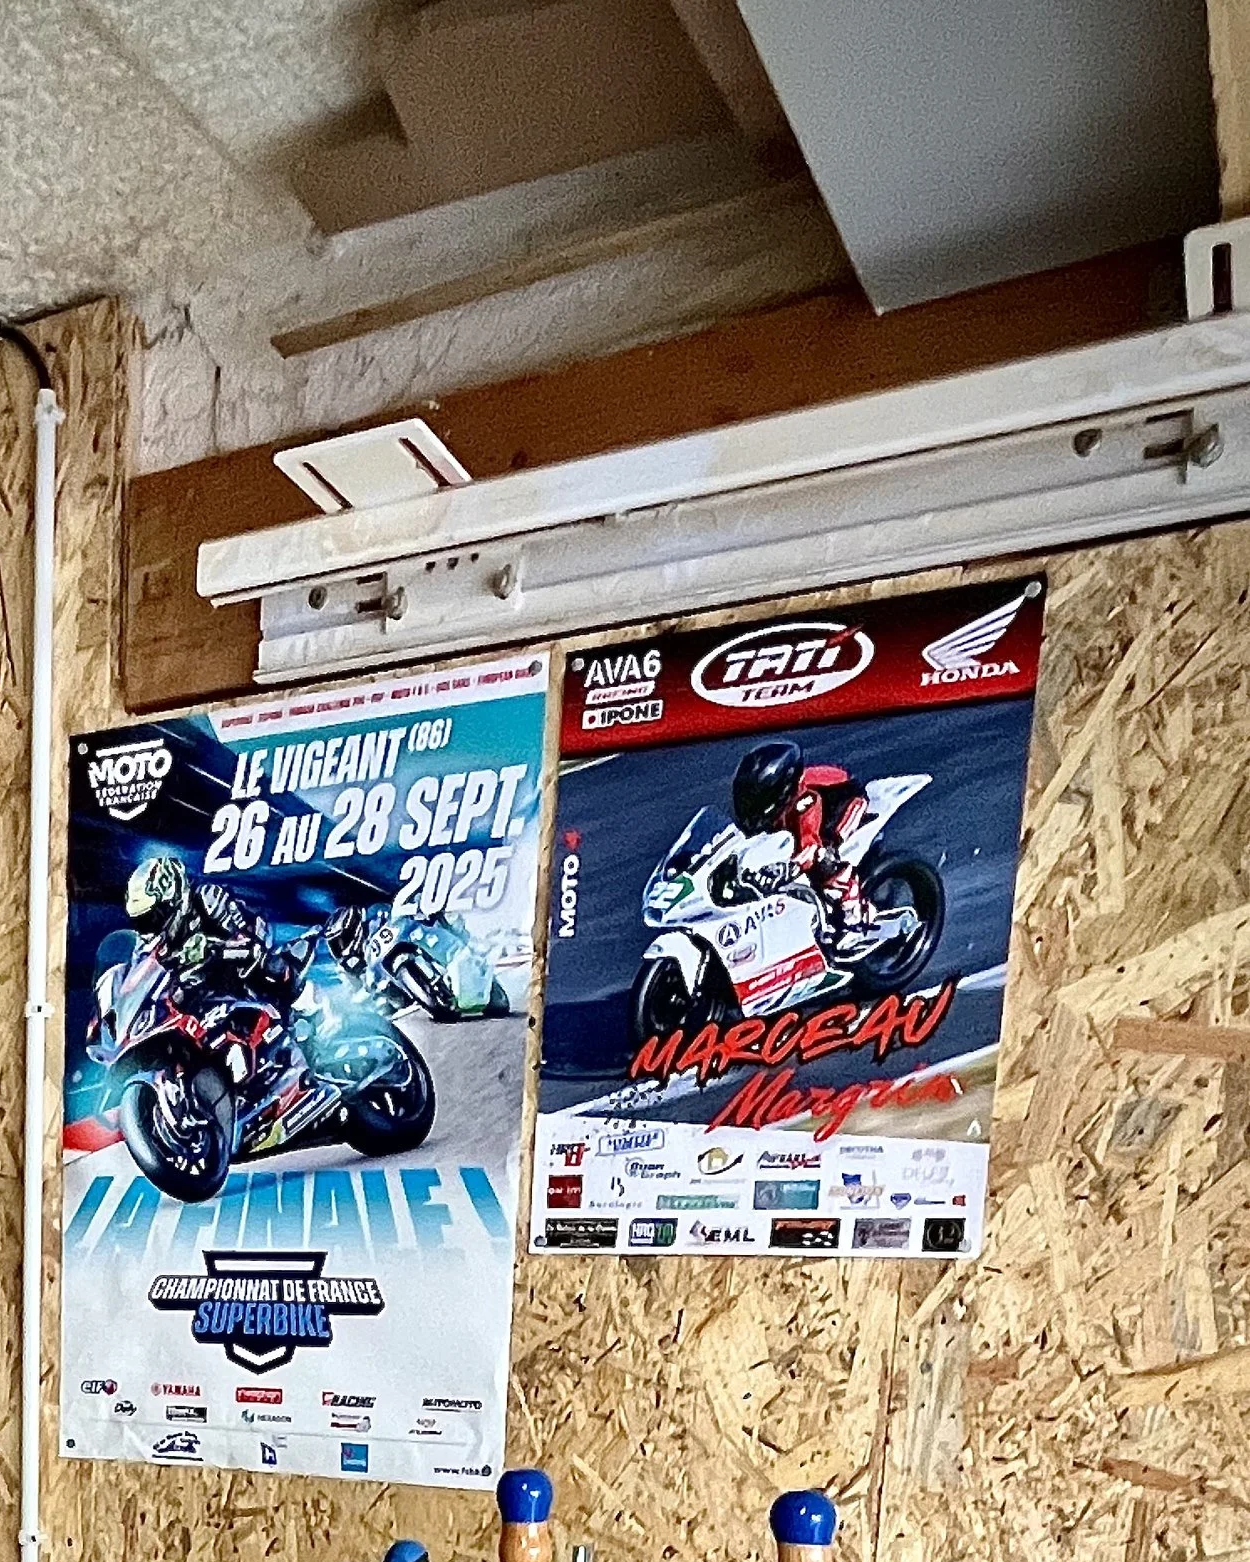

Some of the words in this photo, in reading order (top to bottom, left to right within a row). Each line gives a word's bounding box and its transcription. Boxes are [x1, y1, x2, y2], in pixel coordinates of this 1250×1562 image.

[583, 648, 661, 688] AVA6
[920, 660, 1021, 686] HONDA
[741, 680, 816, 703] TEAM
[600, 702, 660, 726] IPONE
[88, 748, 172, 788] MOTO
[230, 748, 269, 800] LE
[269, 727, 408, 794] VIGEANT
[407, 717, 453, 752] (86)
[202, 800, 270, 874] 26
[270, 812, 323, 866] AU
[323, 782, 397, 860] 28
[398, 763, 528, 850] SEPT.
[390, 845, 513, 918] 2025
[557, 854, 580, 937] MOTO
[629, 980, 955, 1080] MARCEAU
[151, 1277, 280, 1302] CHAMPIONNAT
[282, 1279, 307, 1302] DE
[307, 1280, 382, 1304] FRANCE
[194, 1301, 330, 1338] SUPERBIKE
[162, 1385, 201, 1397] YAMAHA
